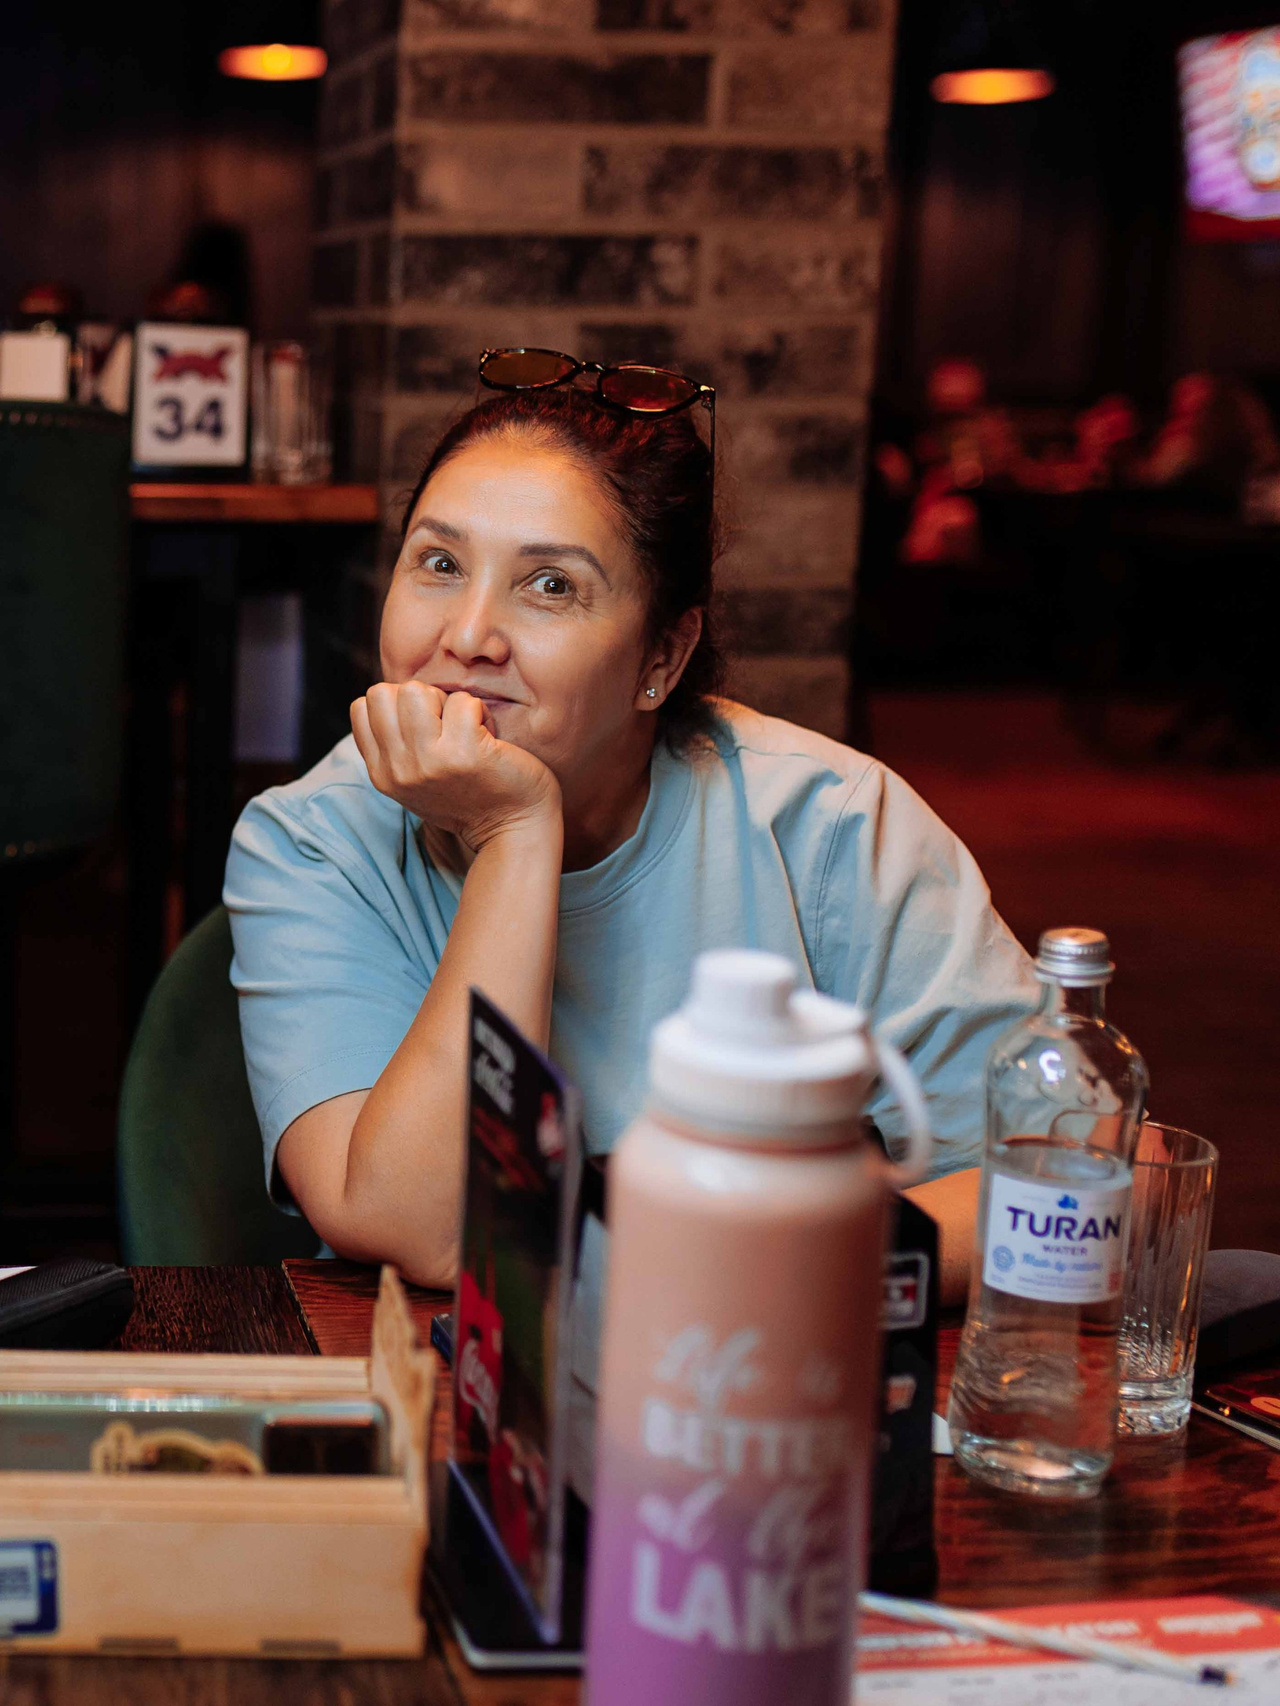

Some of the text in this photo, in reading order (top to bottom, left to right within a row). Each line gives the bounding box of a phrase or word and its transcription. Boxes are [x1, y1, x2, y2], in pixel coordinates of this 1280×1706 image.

[154, 395, 224, 441] 34
[1006, 1205, 1121, 1241] TURAN
[633, 1540, 843, 1653] LAKE
